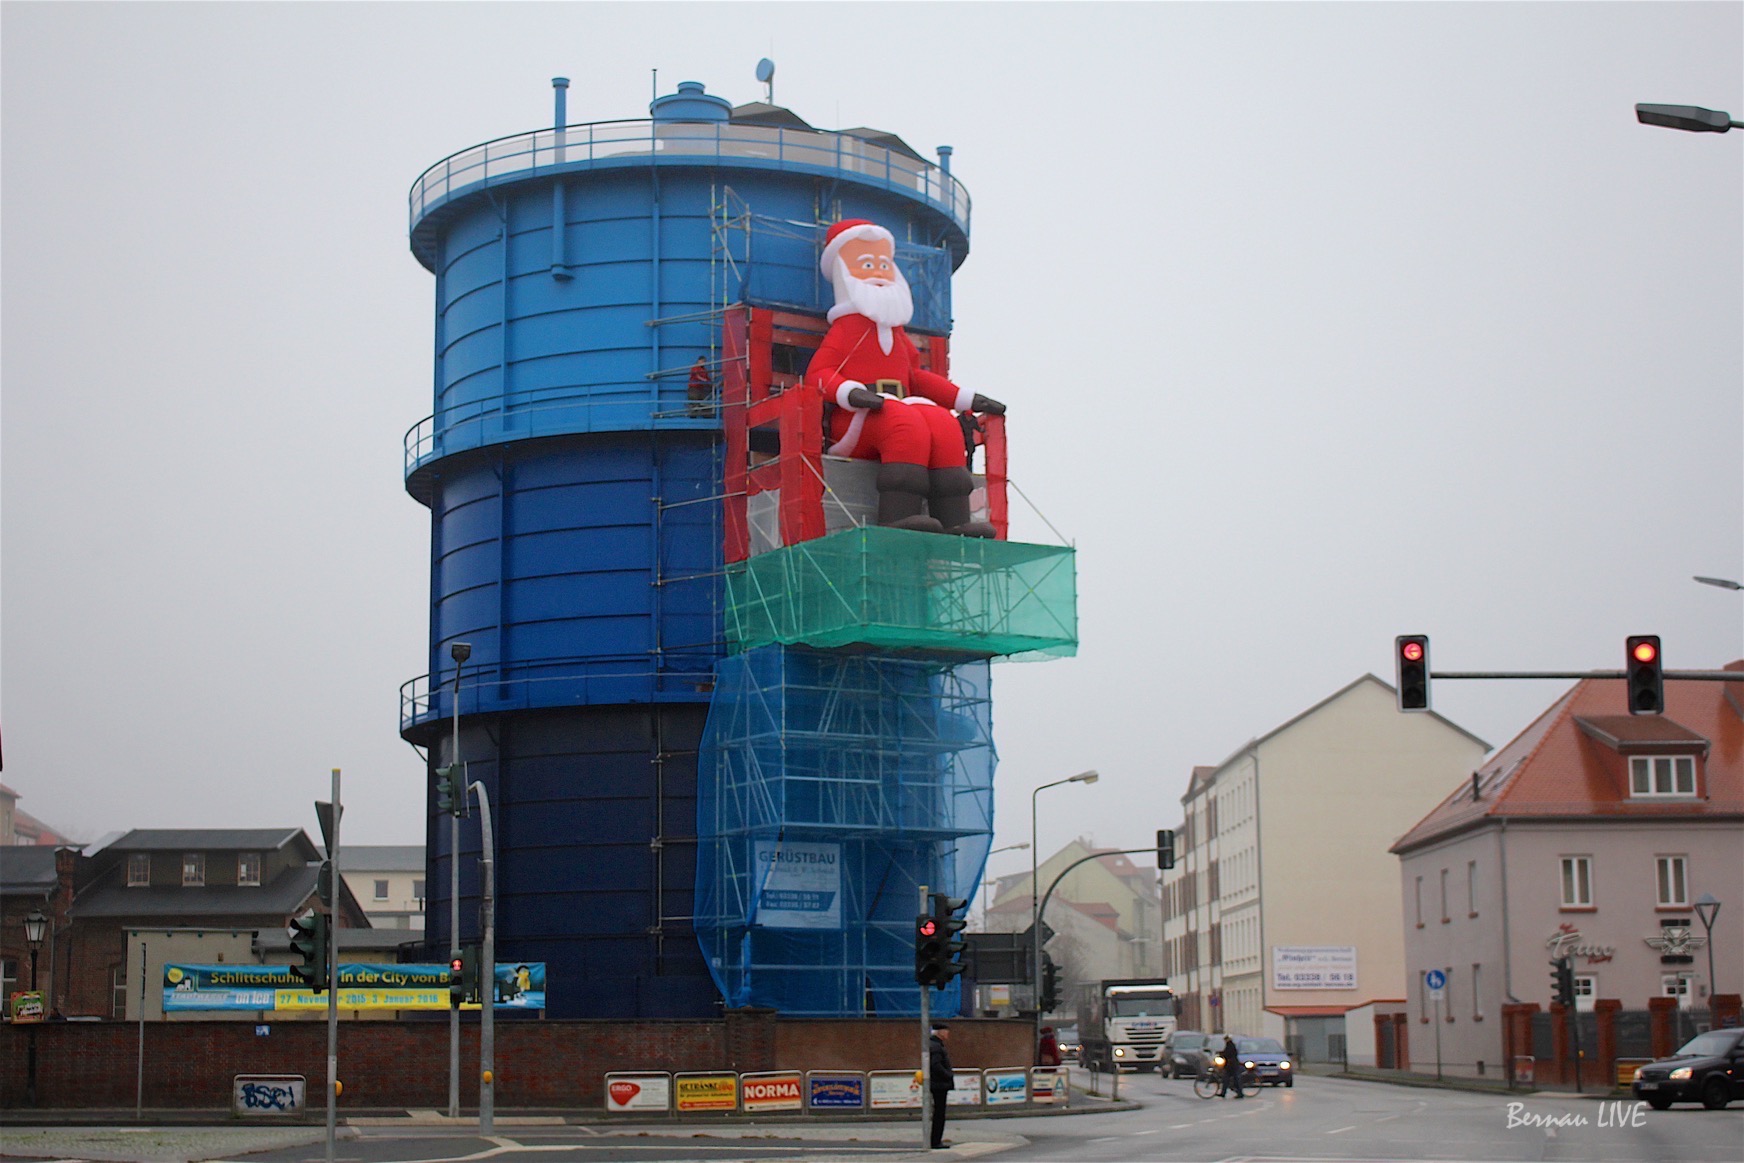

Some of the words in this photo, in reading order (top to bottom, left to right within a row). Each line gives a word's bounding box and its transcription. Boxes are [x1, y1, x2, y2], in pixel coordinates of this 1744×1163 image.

[758, 848, 836, 865] GERÜSTBAU
[211, 971, 329, 984] Schlittschuhl
[341, 971, 353, 983] in
[357, 971, 379, 983] der
[382, 971, 408, 986] City
[411, 974, 436, 983] von
[297, 994, 344, 1004] Novemr
[744, 1083, 799, 1098] NORMA
